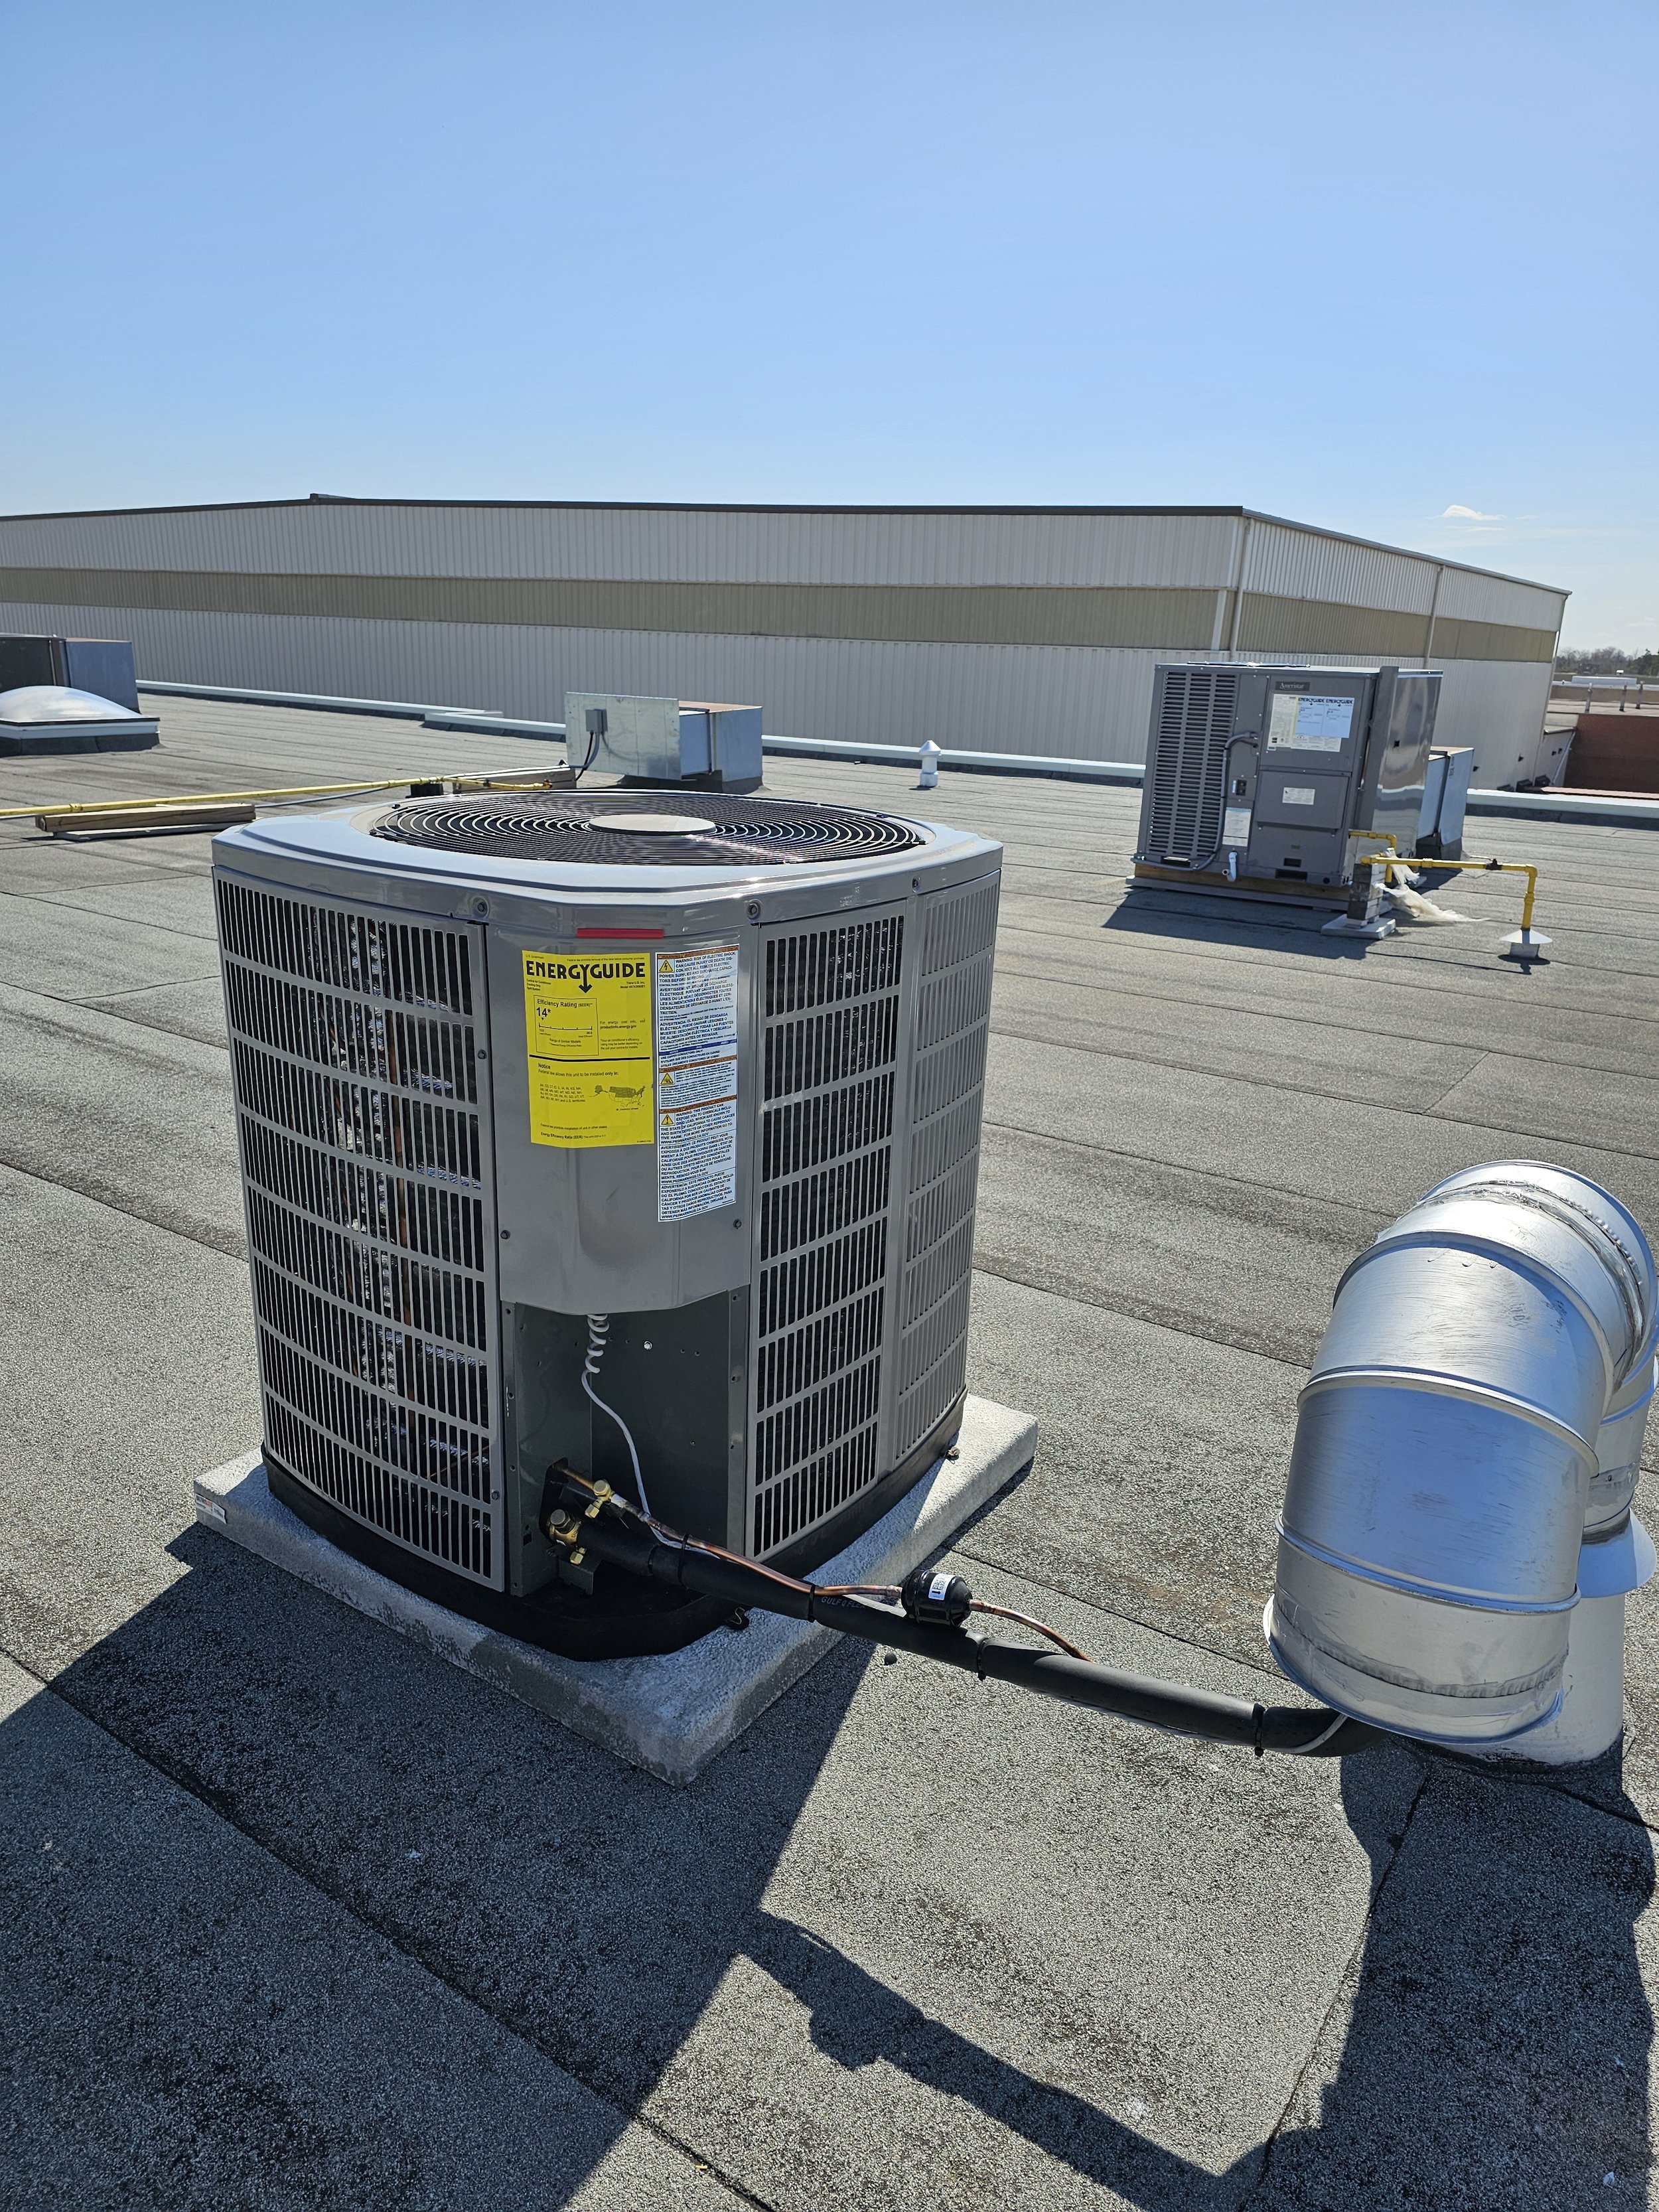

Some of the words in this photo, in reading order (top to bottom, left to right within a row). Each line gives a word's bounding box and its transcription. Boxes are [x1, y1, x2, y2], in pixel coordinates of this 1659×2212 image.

[526, 960, 645, 980] ENERGYGUIDE
[537, 999, 559, 1008] Efficiency
[701, 1125, 722, 1133] INFORMATION
[821, 1596, 842, 1605] GULF
